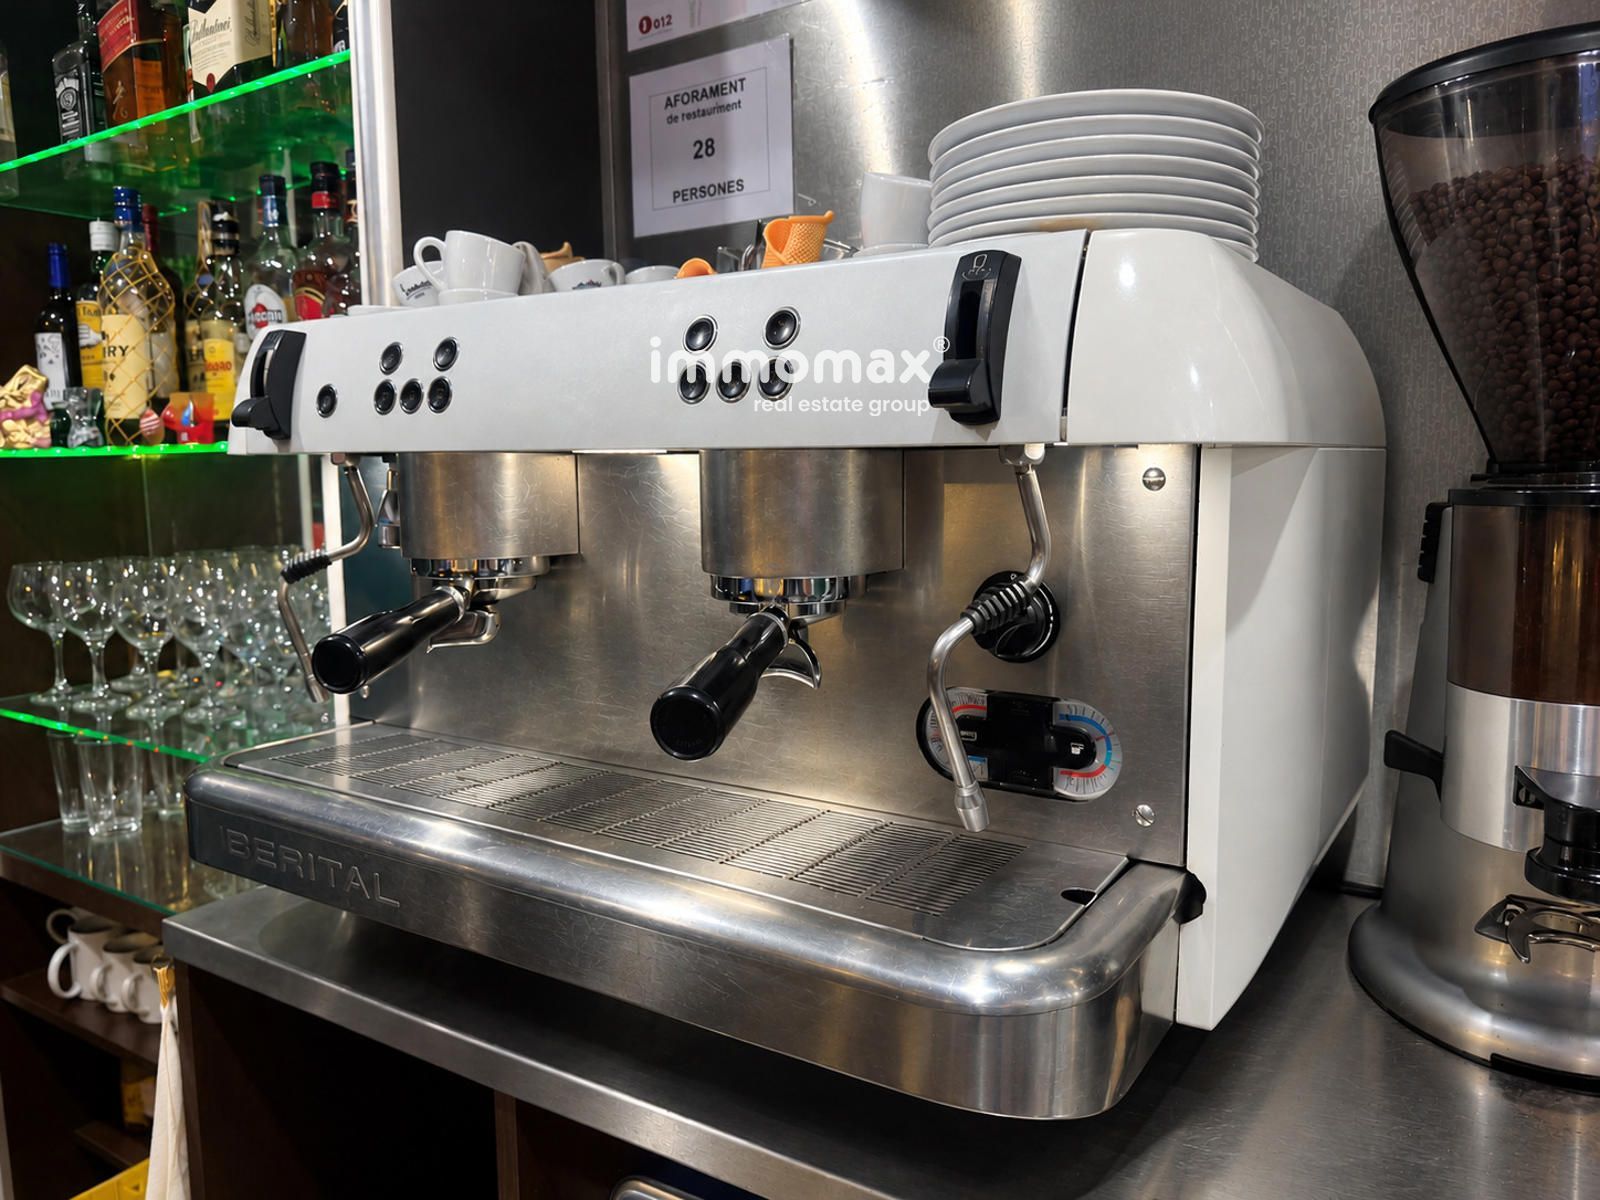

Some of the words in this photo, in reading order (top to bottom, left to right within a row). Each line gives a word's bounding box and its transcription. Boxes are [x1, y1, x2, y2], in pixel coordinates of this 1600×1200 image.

[653, 14, 673, 29] 012
[664, 77, 746, 110] AFORAMENT
[666, 112, 679, 125] de
[693, 137, 715, 160] 28
[672, 178, 745, 204] PERSONES
